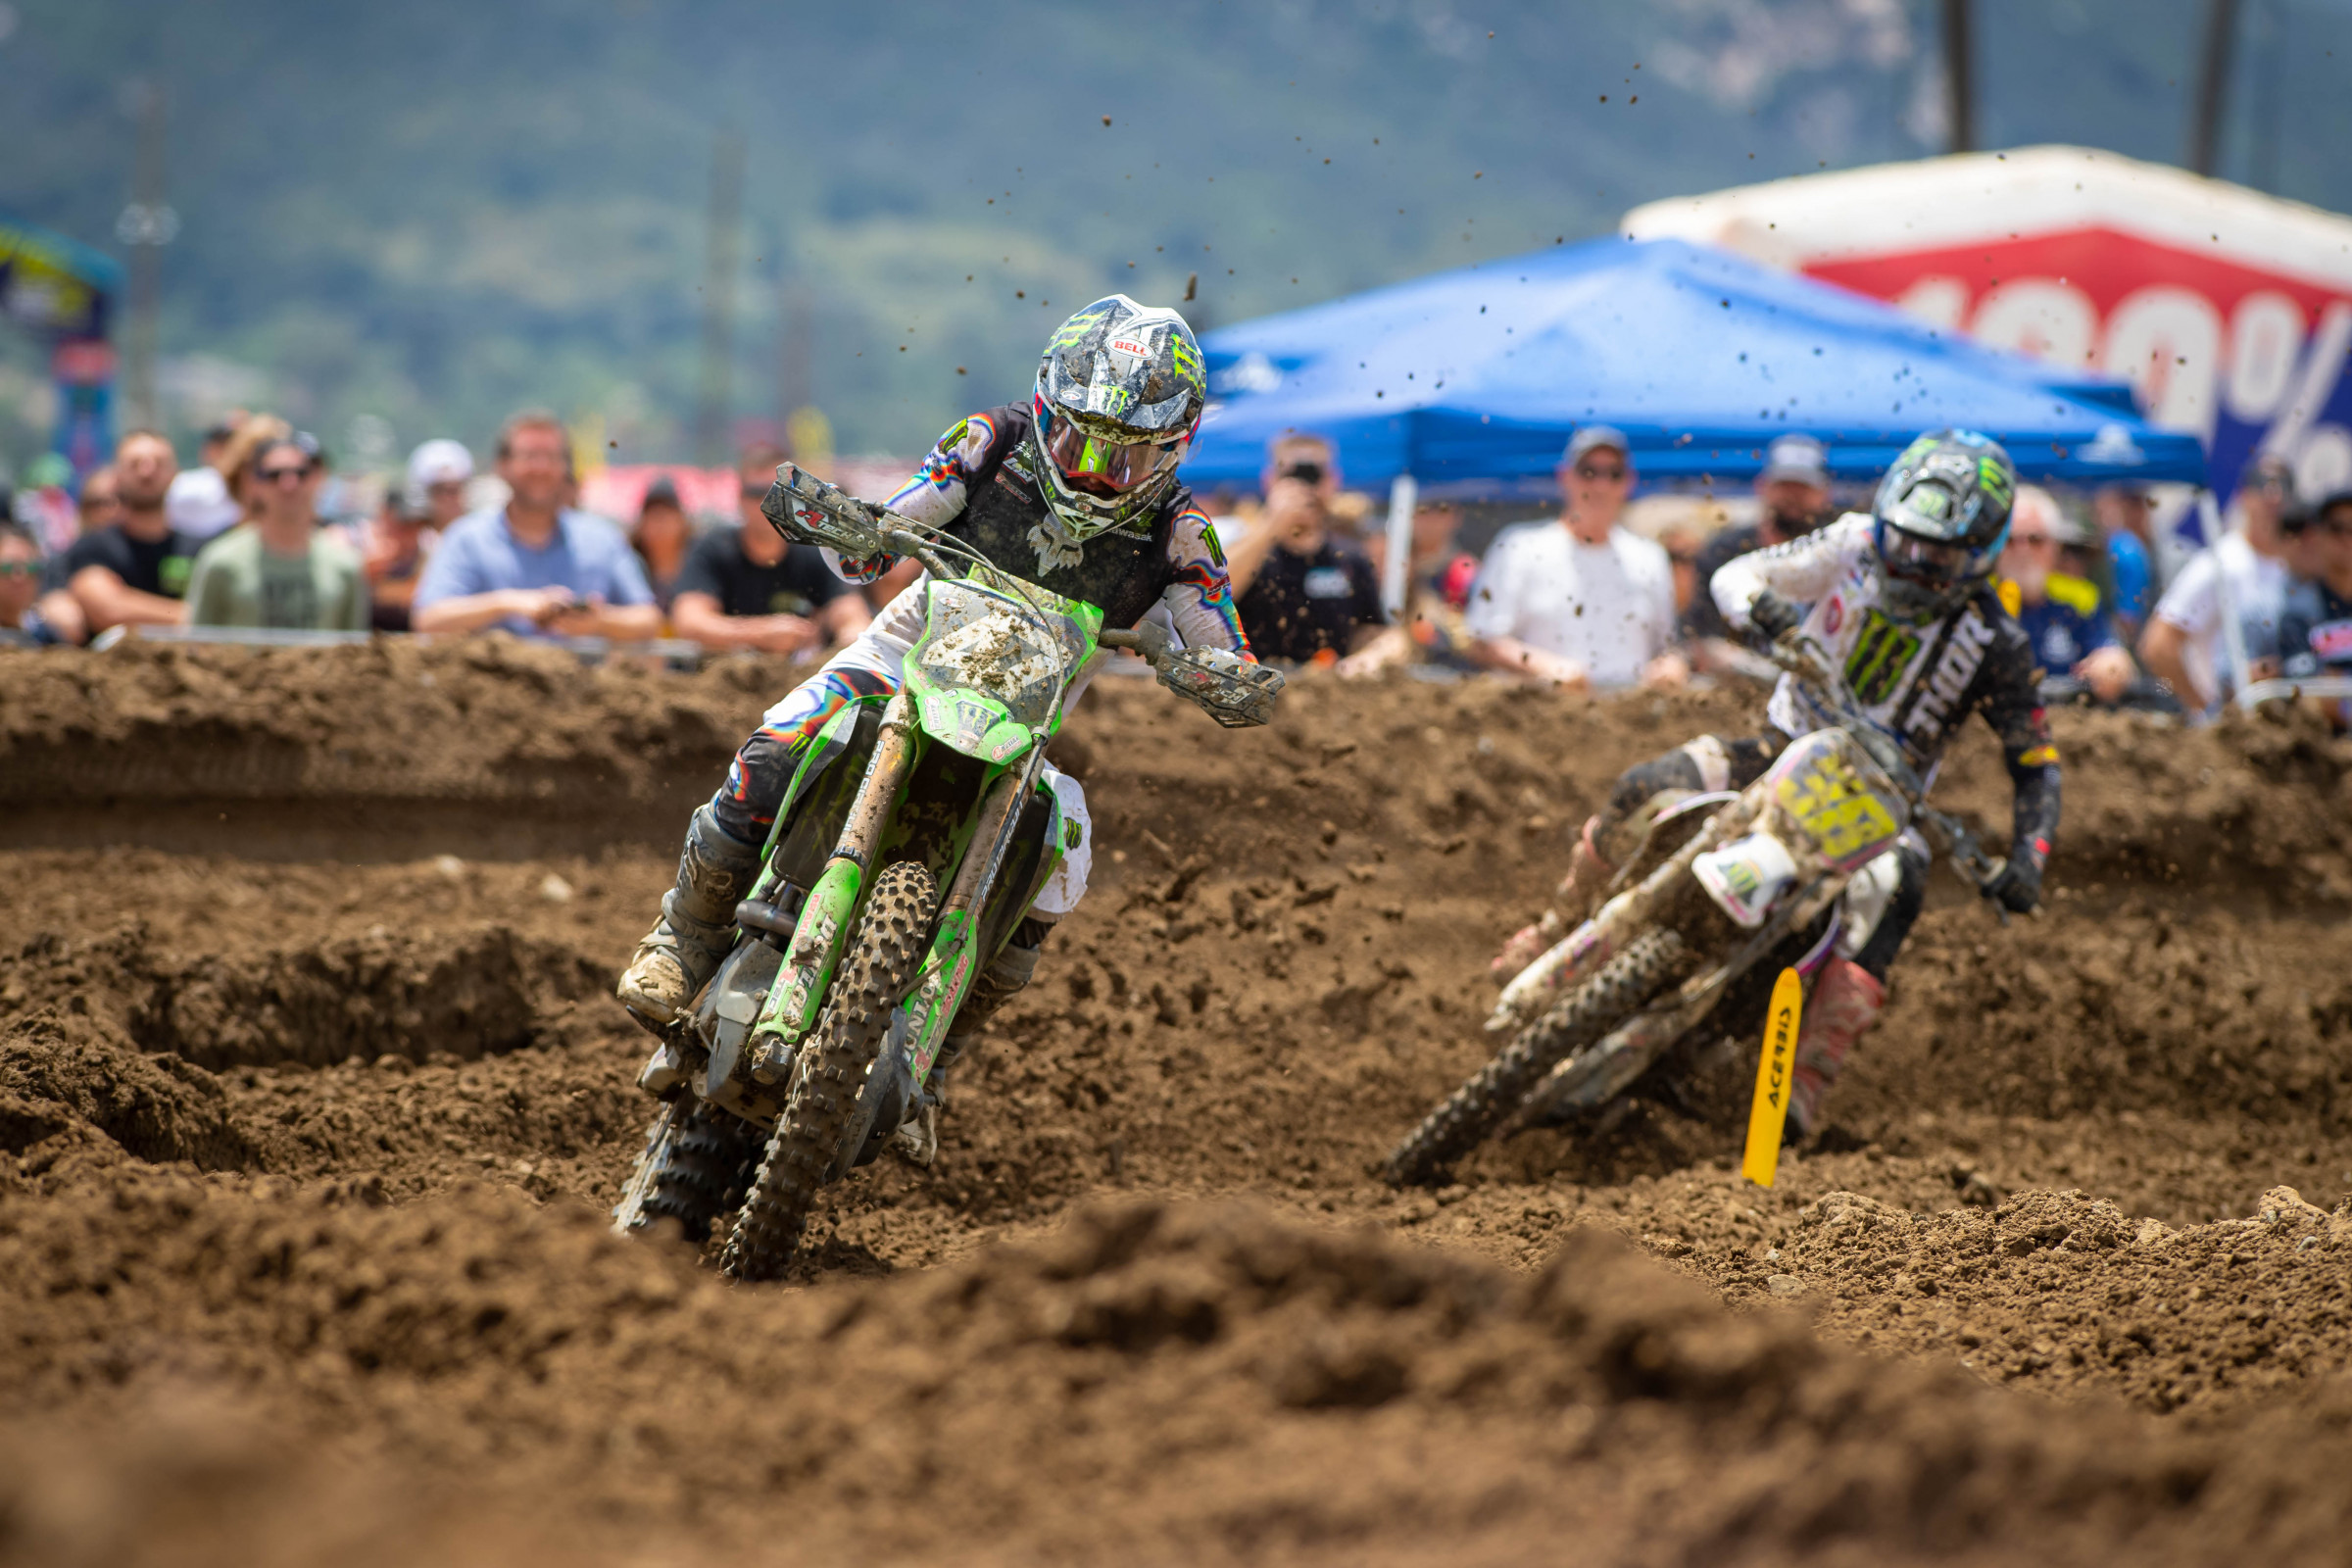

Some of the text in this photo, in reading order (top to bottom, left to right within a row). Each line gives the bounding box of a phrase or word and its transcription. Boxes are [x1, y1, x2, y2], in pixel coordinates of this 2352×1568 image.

[1113, 340, 1148, 357] BELL
[1107, 527, 1152, 542] awasak
[1903, 610, 1996, 735] THOR
[842, 740, 885, 841] PRO CIRCUI
[981, 801, 1023, 902] PRO CIRCUIT
[784, 913, 838, 1021] DULOP
[941, 954, 969, 1018] BRAKING
[1768, 1005, 1791, 1109] ACERBIS
